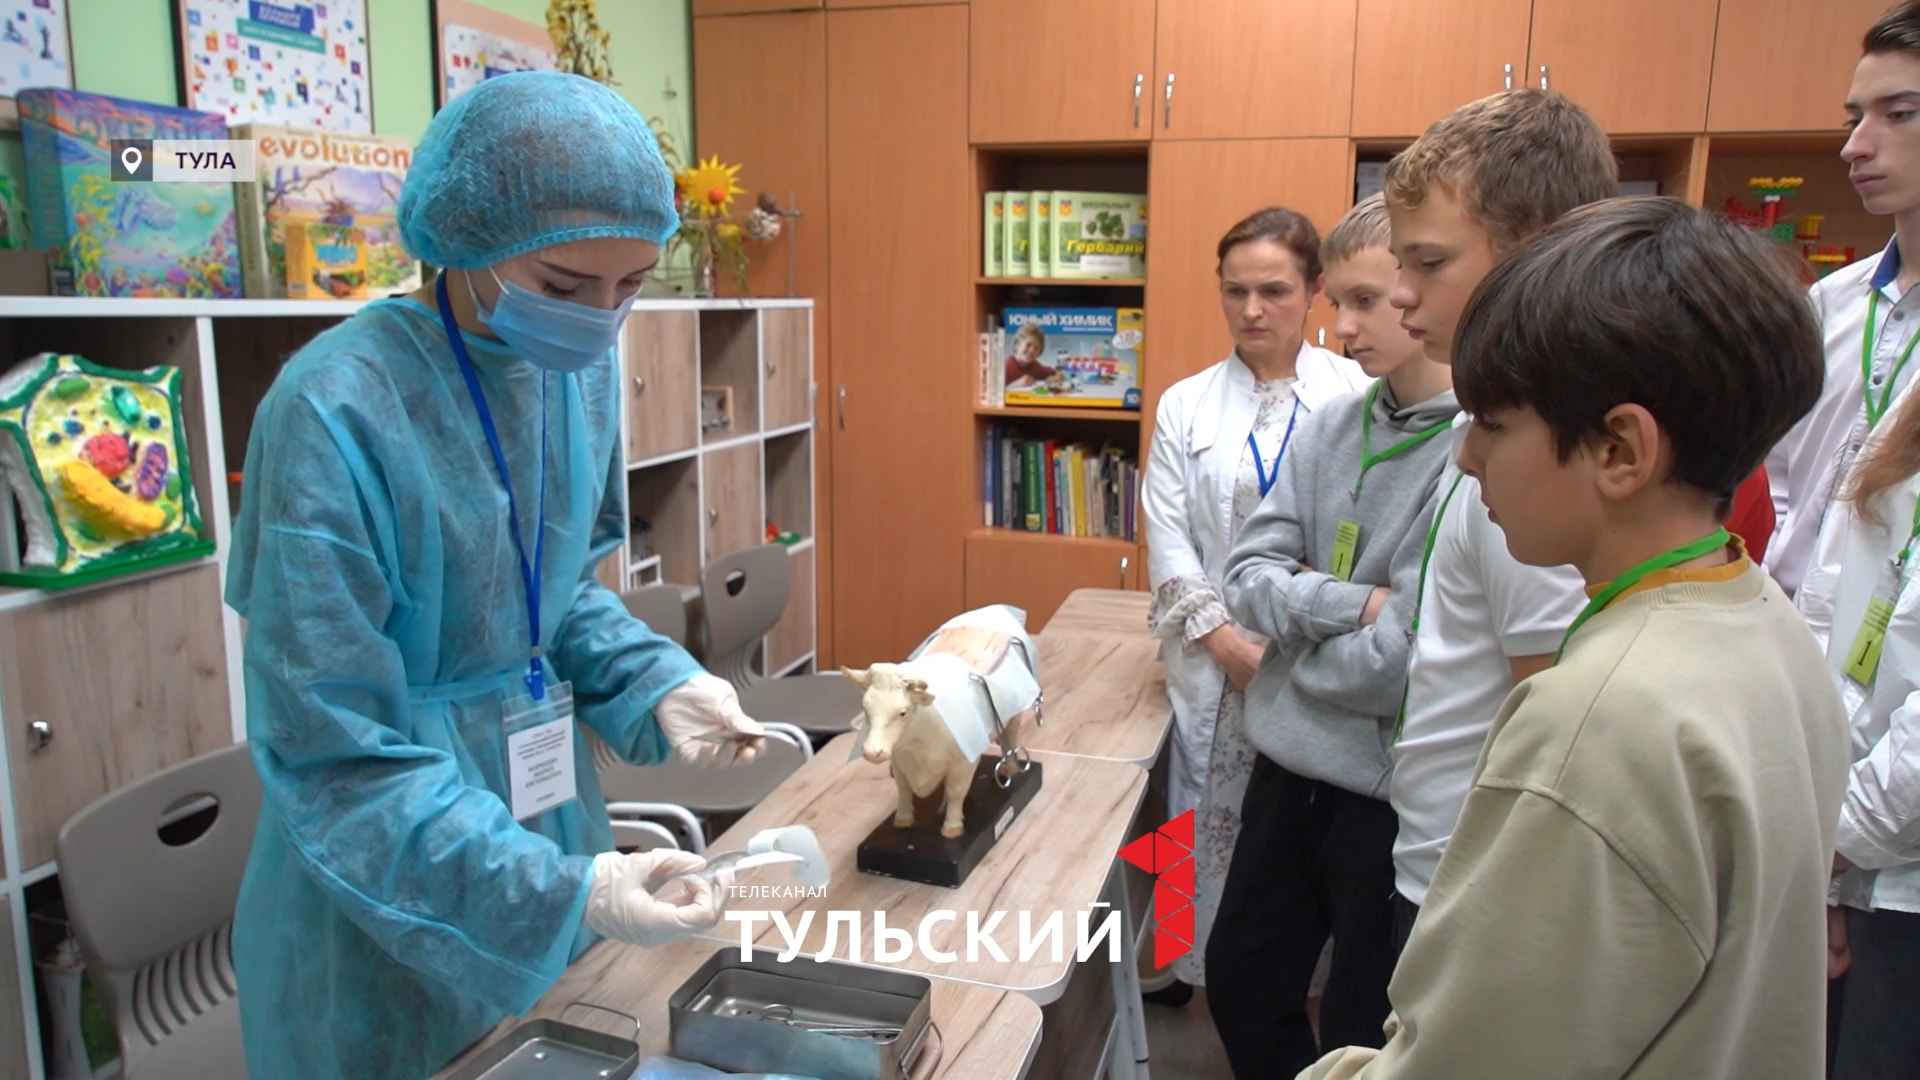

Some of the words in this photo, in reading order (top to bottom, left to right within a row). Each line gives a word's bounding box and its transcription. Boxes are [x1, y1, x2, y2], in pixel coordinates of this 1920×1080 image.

[259, 135, 410, 168] evolution
[1008, 312, 1056, 326] ЮНЫЙ
[1059, 314, 1112, 327] ХИМИК
